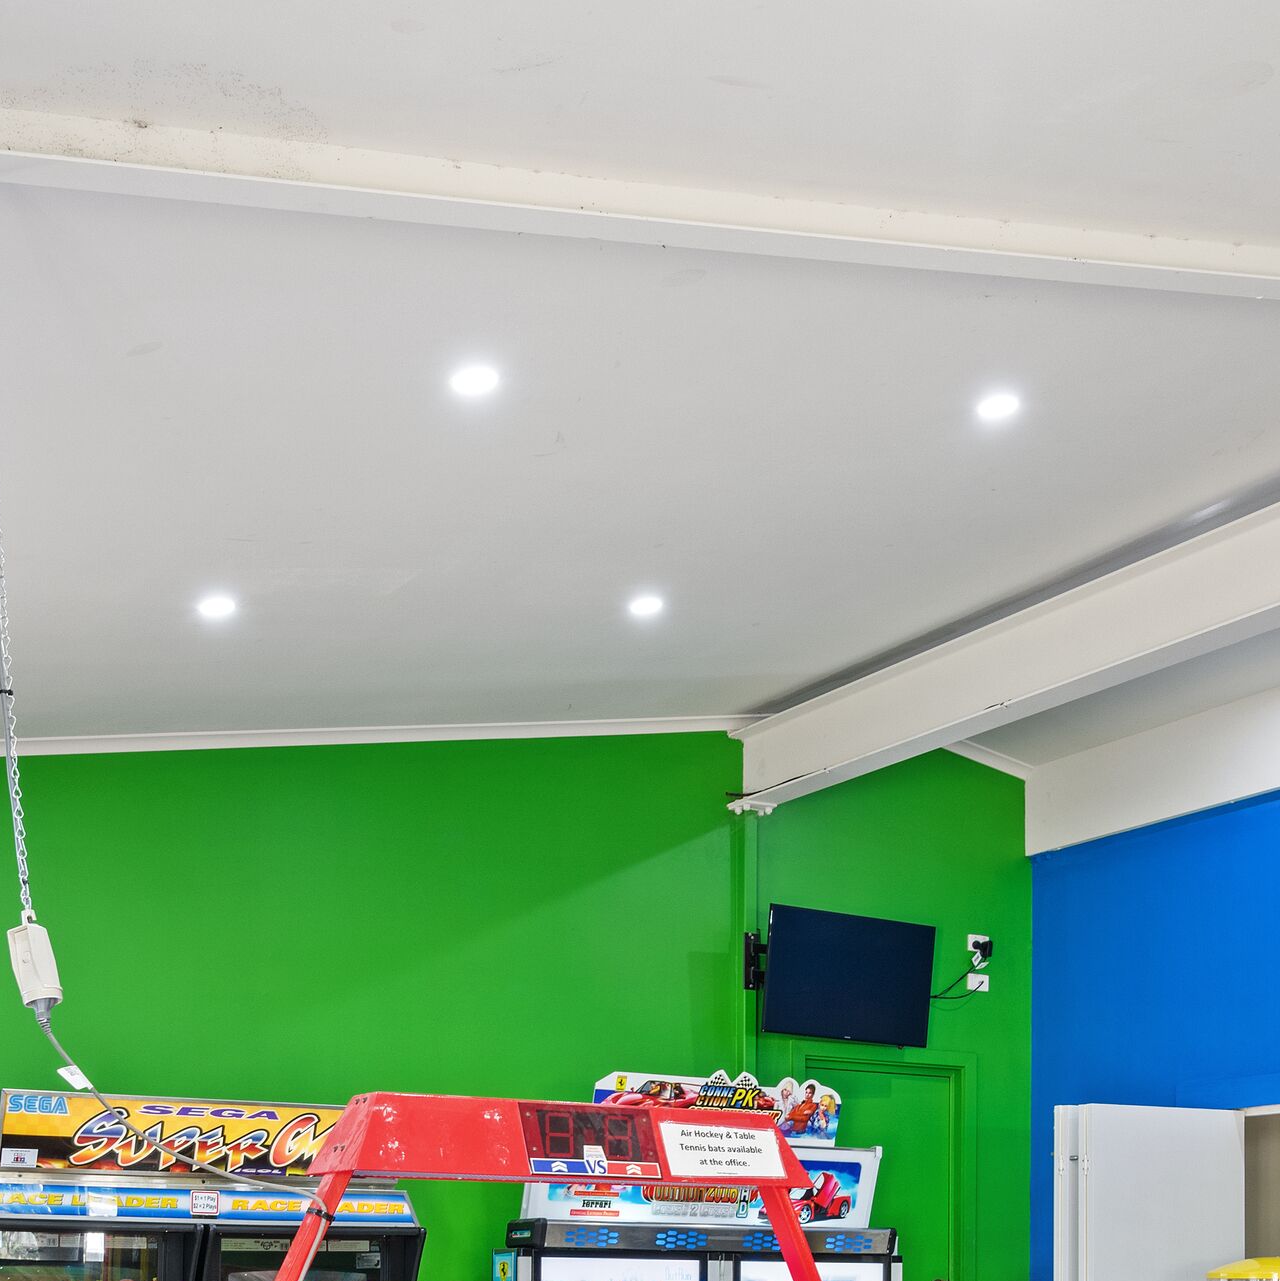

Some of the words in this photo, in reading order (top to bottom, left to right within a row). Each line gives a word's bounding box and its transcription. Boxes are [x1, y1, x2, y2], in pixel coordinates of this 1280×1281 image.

[8, 1095, 70, 1115] SEGA
[731, 1088, 760, 1107] PK
[138, 1104, 280, 1120] SEGA
[70, 1108, 268, 1173] SUPER
[680, 1129, 692, 1138] Air
[694, 1131, 723, 1141] Hockey
[733, 1132, 756, 1140] Table
[679, 1143, 707, 1152] Tennis
[708, 1144, 726, 1152] bats
[727, 1145, 763, 1154] available
[585, 1159, 607, 1174] VS
[725, 1159, 751, 1167] office.
[231, 1199, 303, 1212] RACE
[336, 1201, 405, 1214] ADER
